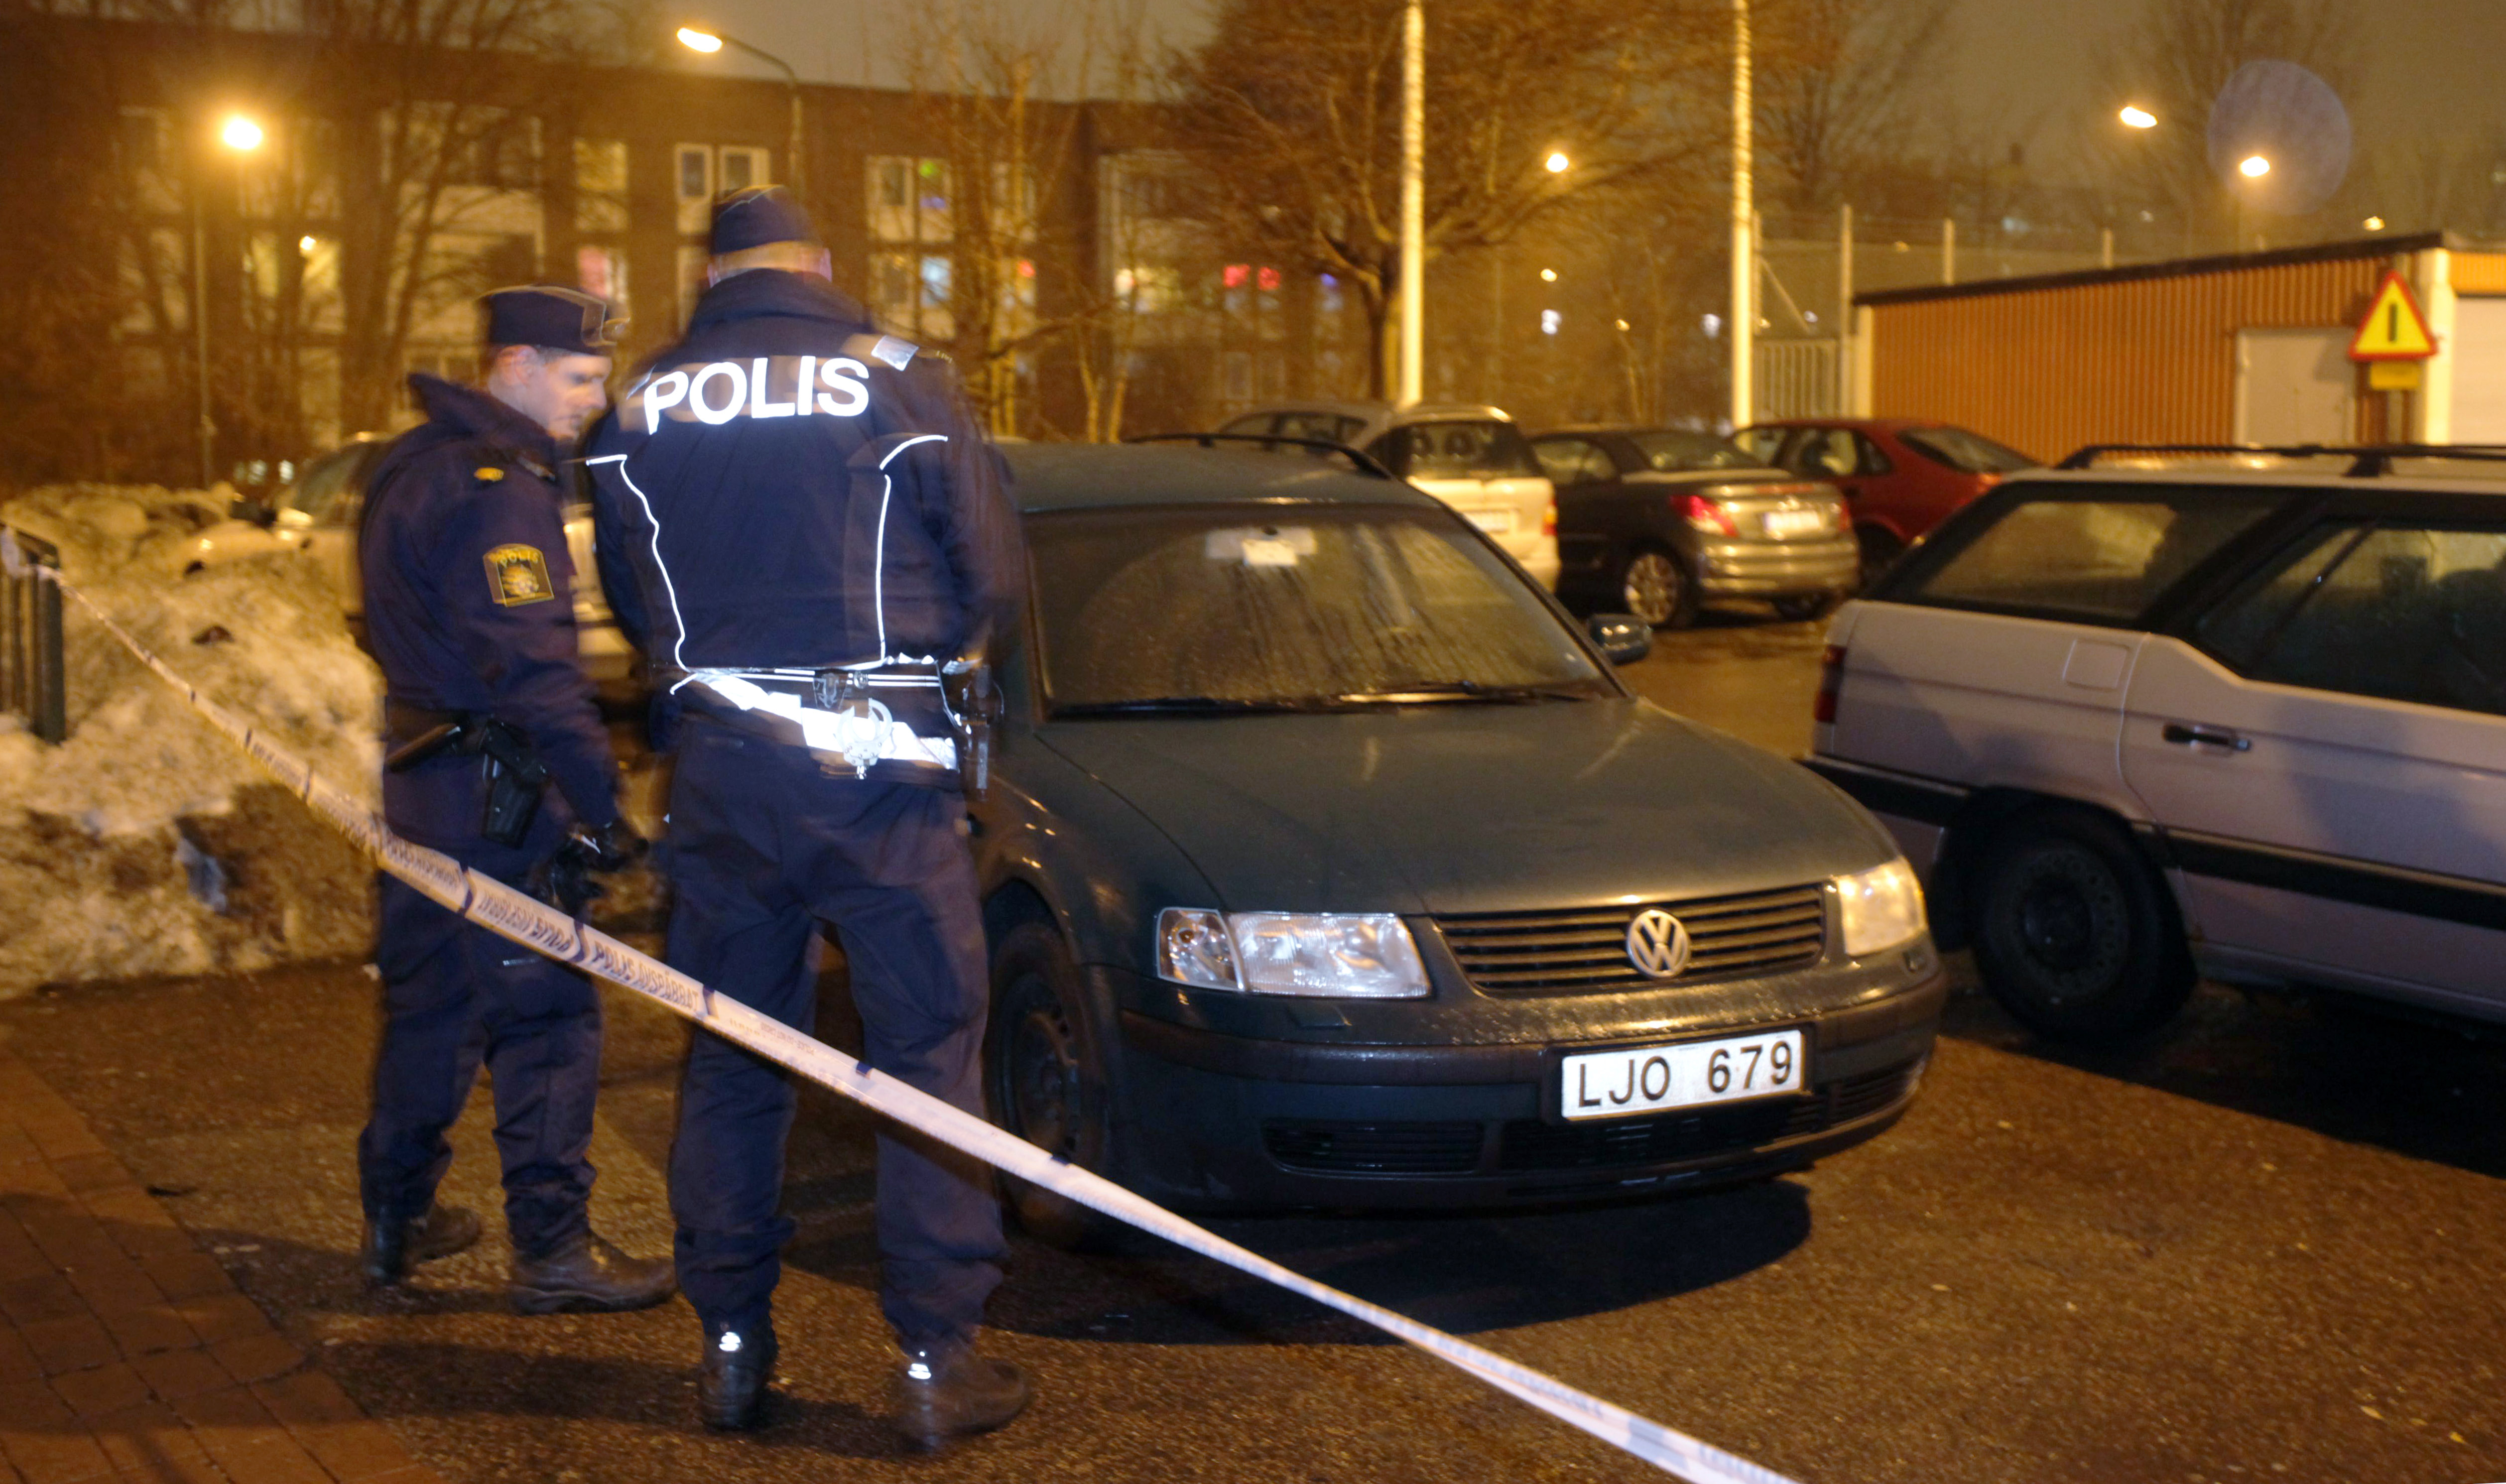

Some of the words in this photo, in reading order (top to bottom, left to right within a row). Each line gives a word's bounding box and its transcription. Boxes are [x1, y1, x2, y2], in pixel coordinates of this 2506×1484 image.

[644, 356, 870, 435] POLIS
[500, 550, 538, 568] POLIS
[592, 940, 636, 981] POLIS
[634, 962, 699, 1012] AVSPÄRRAT
[1627, 909, 1691, 978] VW
[1579, 1056, 1670, 1108] LJO
[1708, 1040, 1792, 1093] 679
